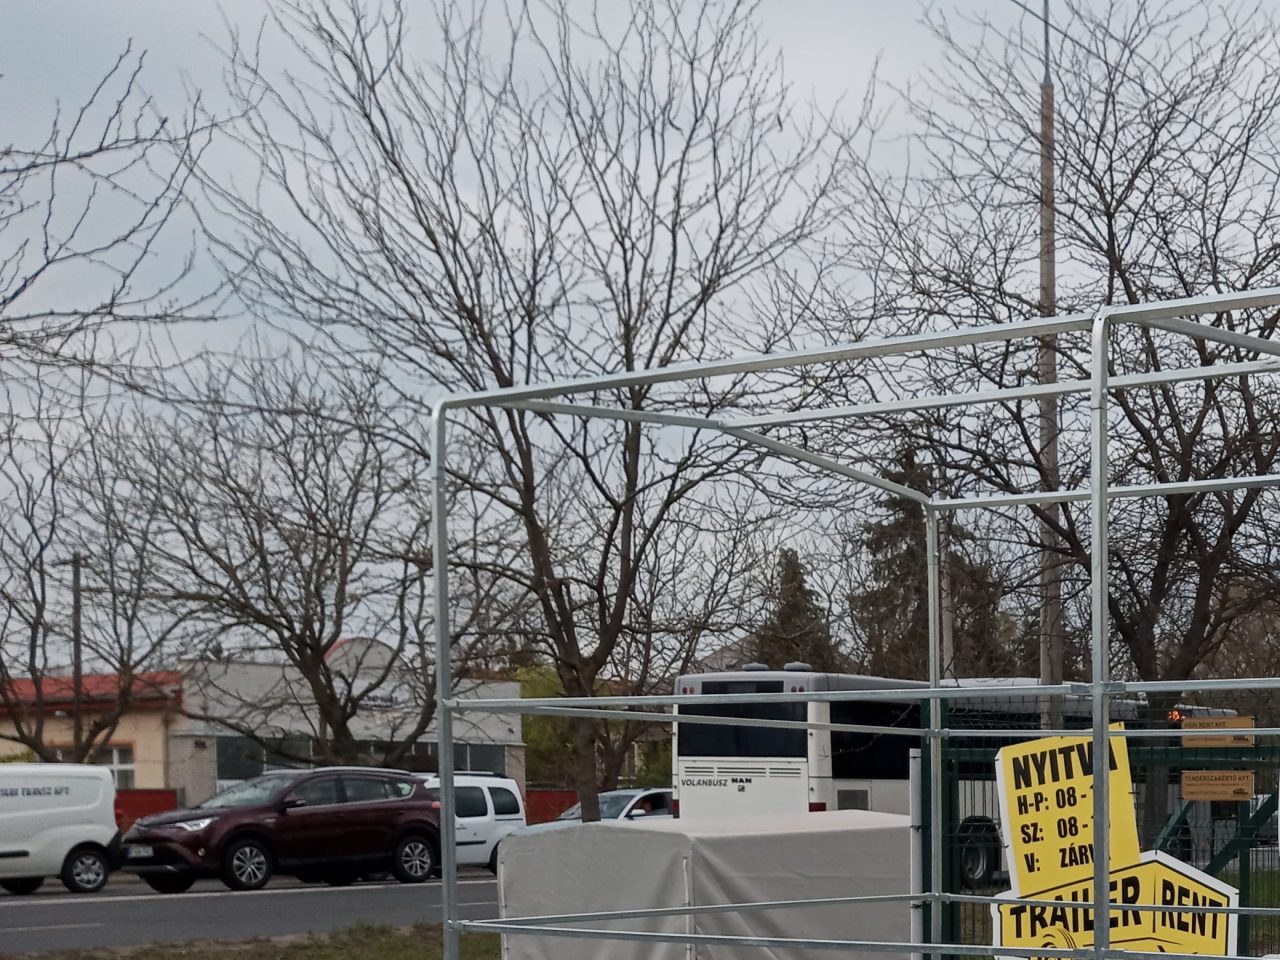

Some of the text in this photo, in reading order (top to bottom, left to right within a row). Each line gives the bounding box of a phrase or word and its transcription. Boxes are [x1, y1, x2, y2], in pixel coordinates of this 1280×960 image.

[1017, 791, 1049, 816] H-P:
[1055, 786, 1078, 809] 08
[1020, 822, 1045, 845] SZ:
[1057, 816, 1079, 839] 08
[1024, 852, 1041, 874] V:
[1161, 878, 1223, 940] RENT
